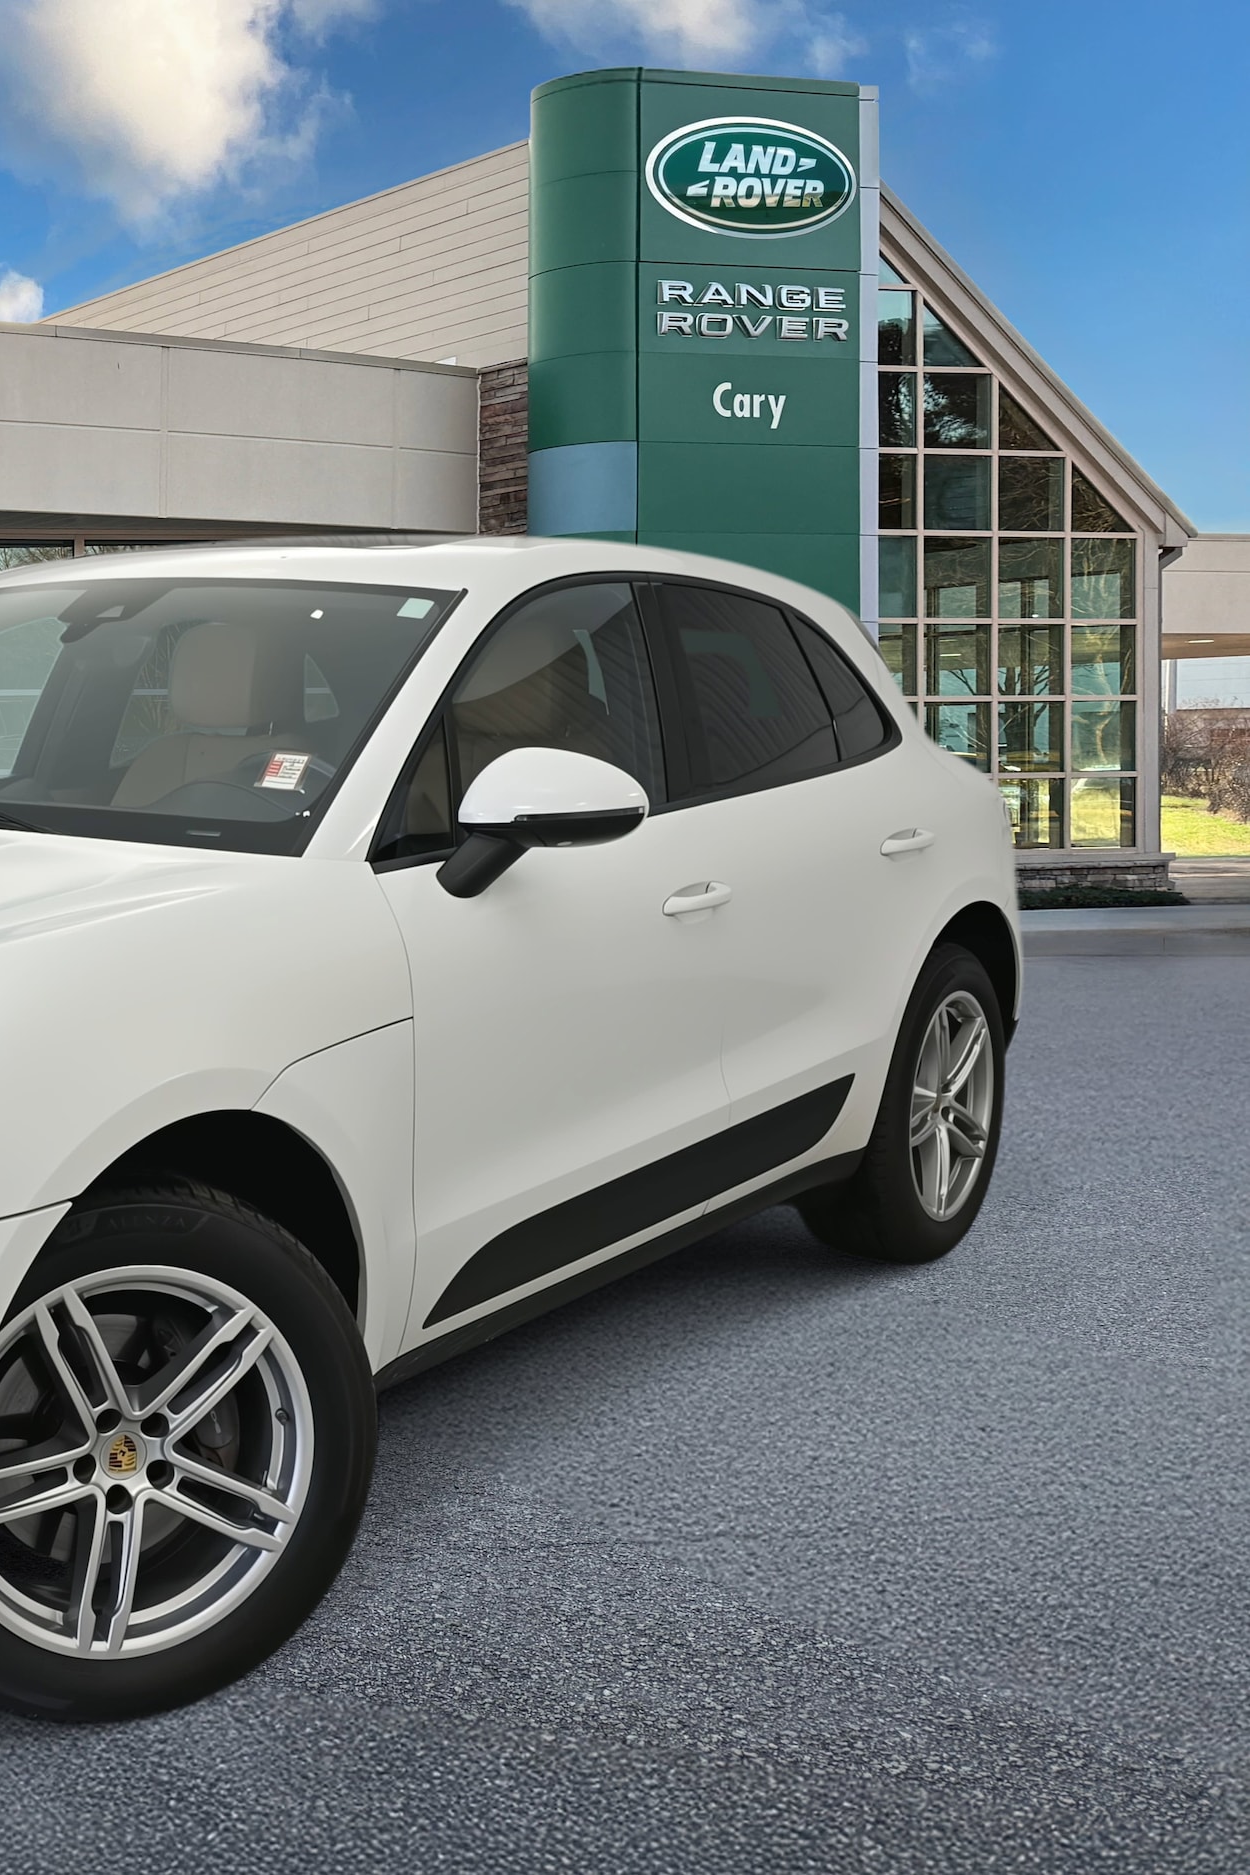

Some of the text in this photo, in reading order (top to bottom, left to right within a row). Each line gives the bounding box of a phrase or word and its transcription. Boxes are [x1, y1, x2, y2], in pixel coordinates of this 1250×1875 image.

[697, 141, 797, 176] LAND
[709, 175, 825, 208] ROVER
[656, 279, 848, 312] RANGE
[656, 311, 850, 343] ROVER
[712, 381, 787, 430] Cary
